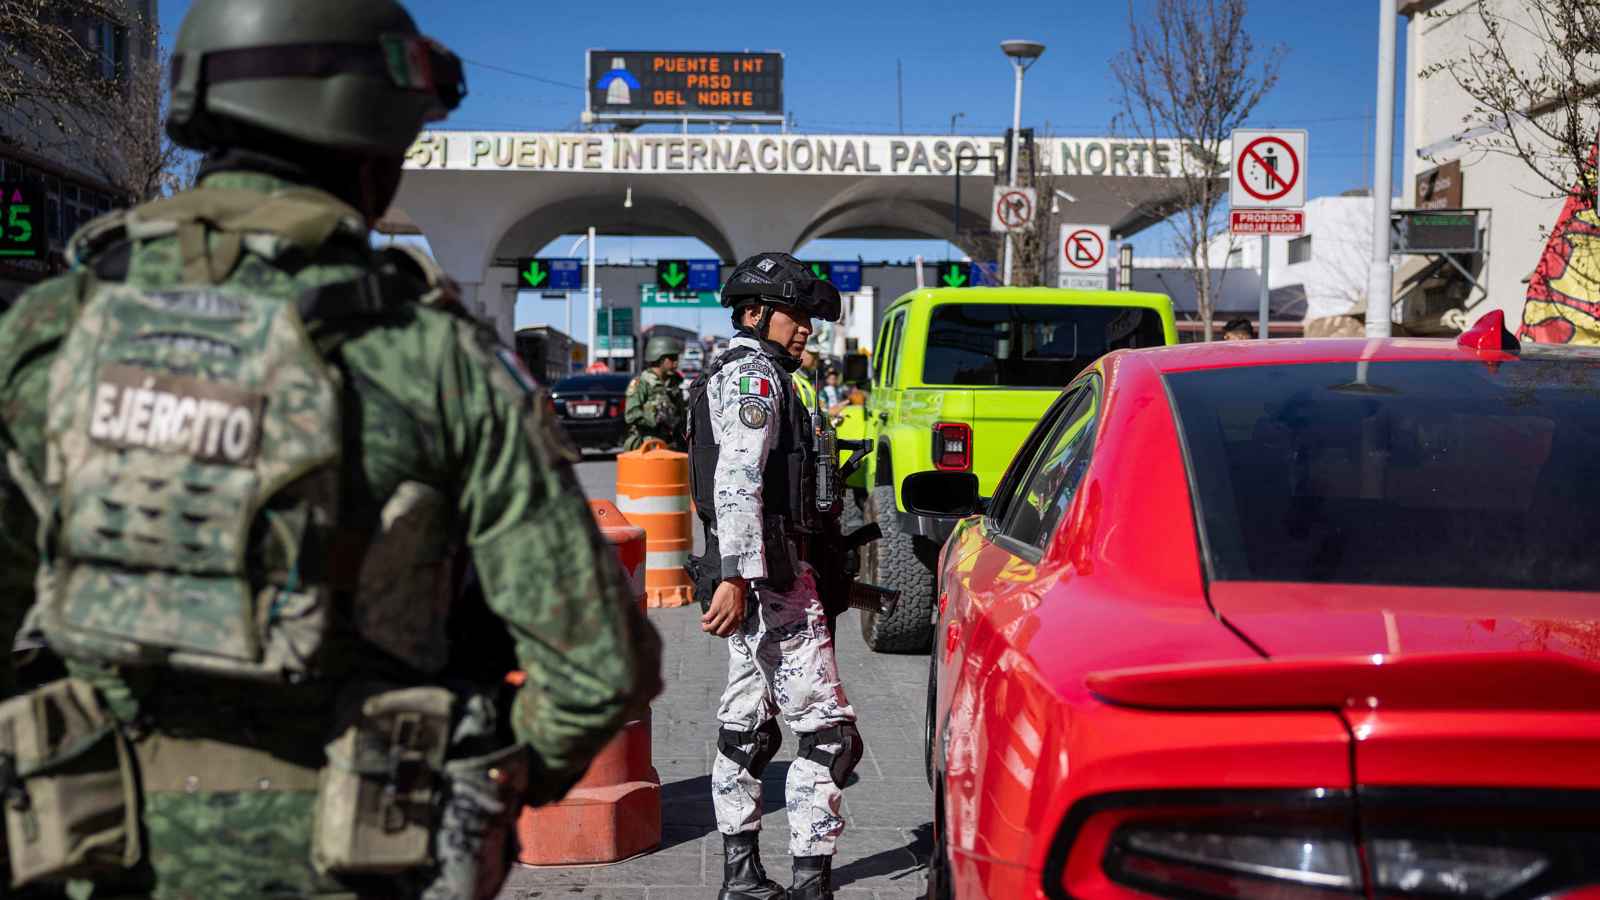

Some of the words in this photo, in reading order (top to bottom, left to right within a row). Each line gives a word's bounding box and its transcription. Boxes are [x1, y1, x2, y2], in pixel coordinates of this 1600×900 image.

[653, 56, 720, 73] PUENTE
[733, 57, 764, 73] INT
[686, 74, 732, 89] PASO
[653, 90, 686, 105] DEL
[698, 91, 753, 106] NORTE
[470, 136, 602, 169] PUENTE
[612, 137, 882, 173] INTERNACIONAL
[889, 139, 979, 174] PASO
[1060, 141, 1171, 176] NORTE
[1239, 213, 1296, 223] PROHIBIDO
[90, 376, 252, 460] EJÉRCITO
